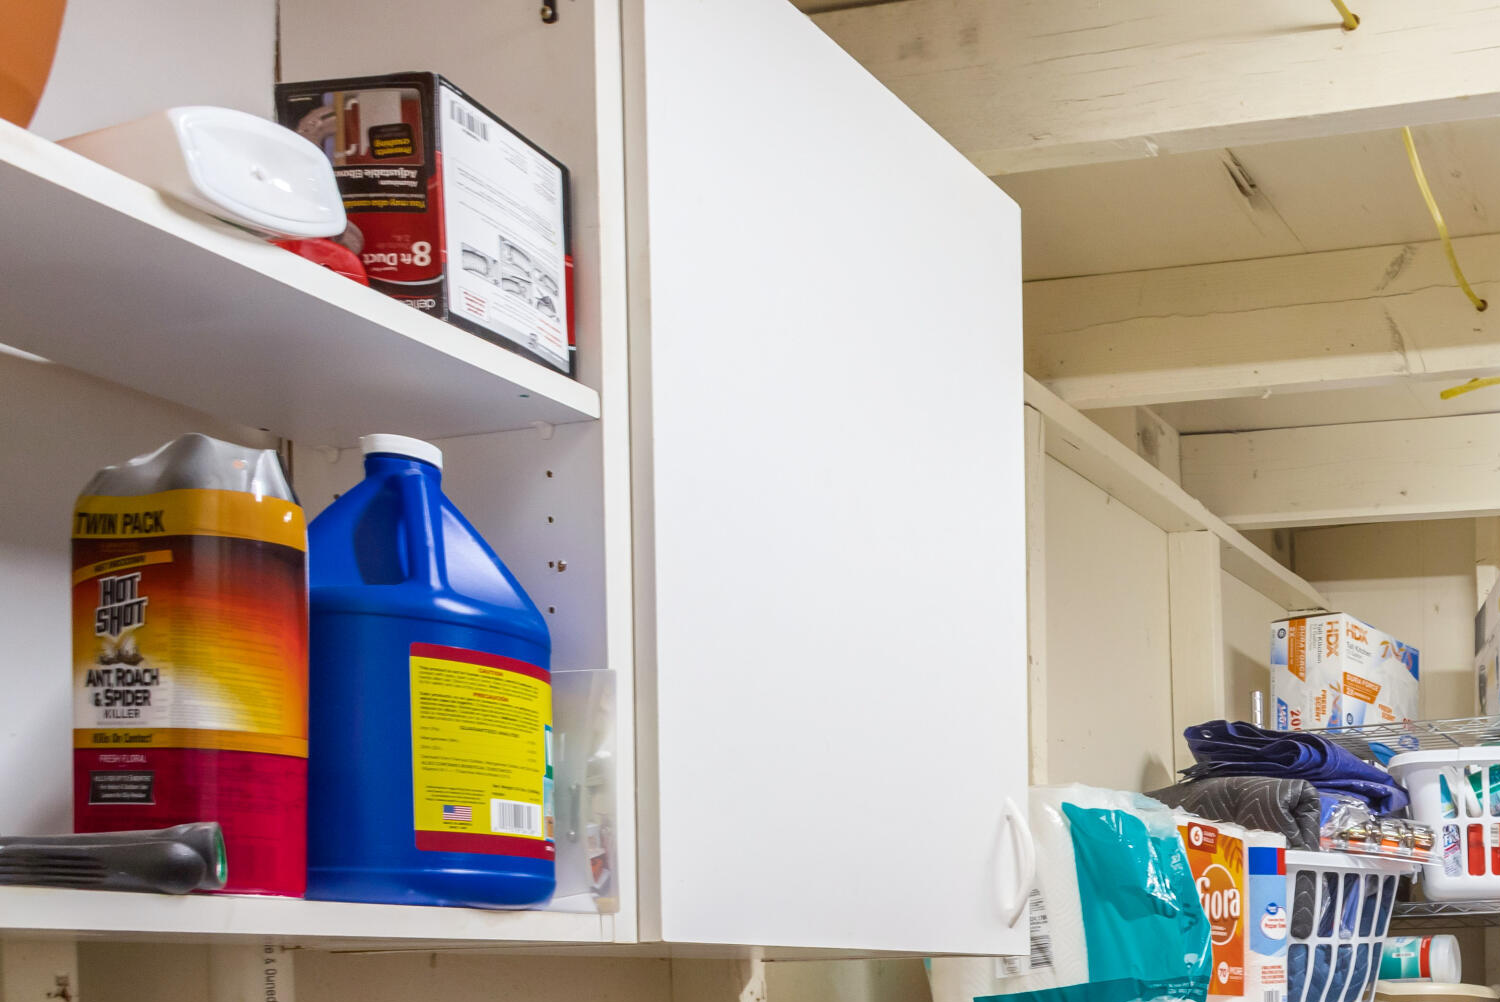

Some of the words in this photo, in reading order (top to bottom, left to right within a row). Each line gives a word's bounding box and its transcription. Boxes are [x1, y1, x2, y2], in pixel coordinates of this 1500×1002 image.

[364, 168, 418, 179] Adjustable
[364, 252, 398, 266] Duct
[400, 253, 412, 265] ft
[411, 241, 432, 266] 8
[76, 512, 117, 534] TWIN
[121, 510, 165, 534] PACK
[98, 572, 142, 605] HOT
[95, 596, 149, 637] SHOT
[1326, 620, 1339, 657] HDX
[1346, 621, 1369, 645] HDX
[115, 668, 159, 687] ROACH
[104, 689, 152, 707] SPIDER
[104, 708, 140, 719] KILLER
